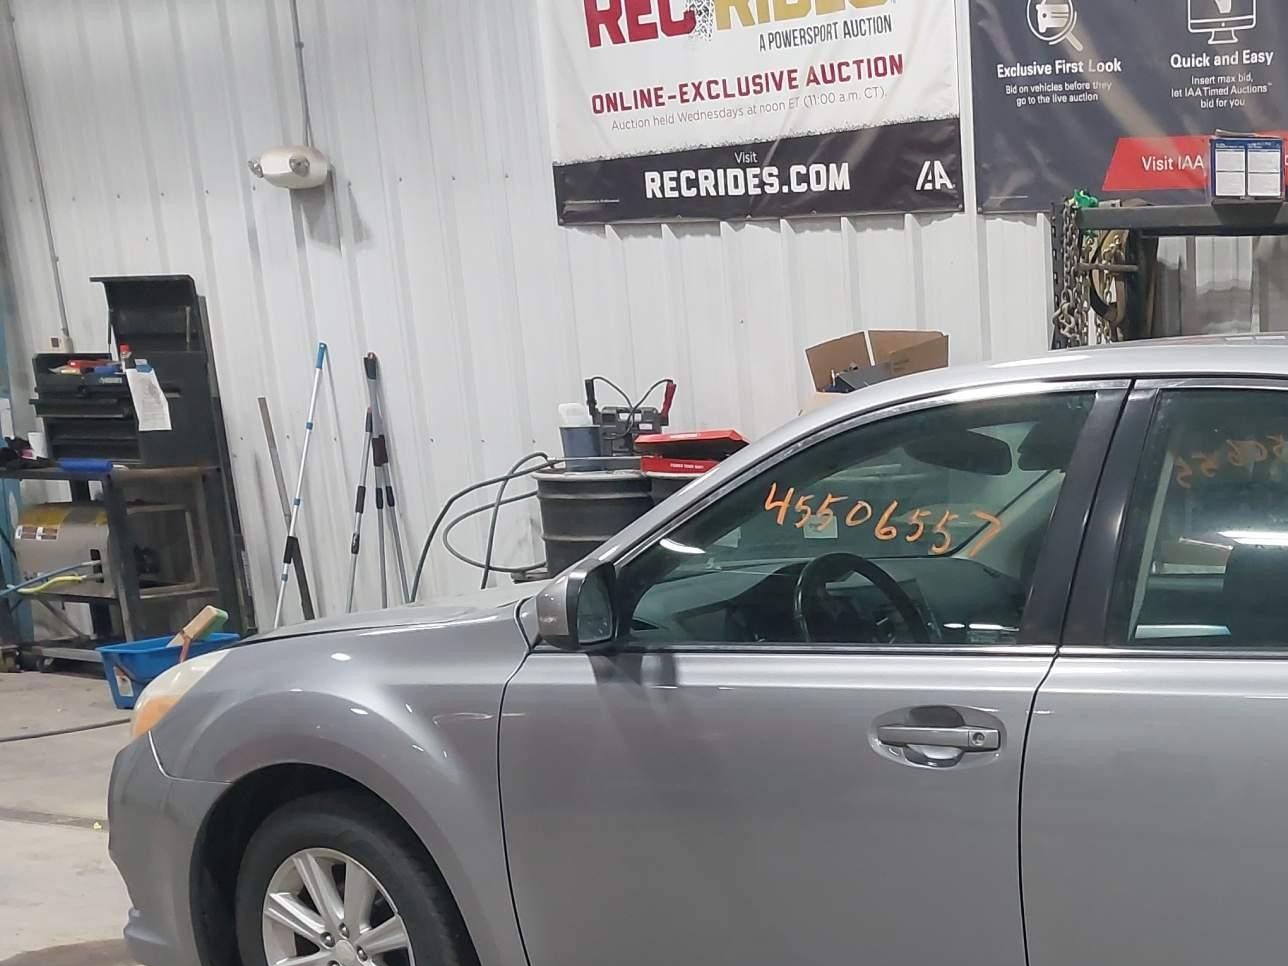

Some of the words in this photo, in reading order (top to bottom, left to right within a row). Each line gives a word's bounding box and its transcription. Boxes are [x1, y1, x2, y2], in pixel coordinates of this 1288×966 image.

[759, 33, 767, 52] A
[768, 22, 839, 50] POWERSPORT
[843, 14, 893, 39] AUCTION
[1170, 53, 1210, 68] Quick
[1213, 51, 1239, 66] and
[1242, 49, 1274, 66] Easy
[996, 61, 1052, 78] Exclusive
[1055, 59, 1084, 74] First
[1088, 57, 1122, 73] Look
[591, 69, 799, 114] ONLINE-EXCLUSIVE
[805, 53, 903, 87] AUCTION
[1005, 84, 1017, 94] Bid
[1018, 86, 1029, 94] on
[1030, 82, 1063, 93] vehicles
[1065, 80, 1090, 91] before
[1092, 80, 1112, 91] they
[1191, 75, 1216, 85] Insert
[1217, 75, 1235, 84] max
[1238, 72, 1253, 83] bid,
[1016, 97, 1026, 107] go
[1027, 96, 1036, 105] to
[1037, 94, 1050, 104] the
[1052, 93, 1067, 103] live
[1069, 92, 1098, 102] auction
[1171, 88, 1182, 98] let
[1184, 87, 1202, 97] IAA
[1203, 86, 1229, 96] Timed
[612, 117, 650, 131] Auction
[653, 114, 674, 127] held
[678, 106, 744, 122] Wednesdays
[747, 105, 757, 116] at
[759, 100, 786, 112] noon
[804, 93, 835, 108] (11:00
[1200, 98, 1214, 109] bid
[1216, 98, 1227, 107] for
[1229, 98, 1245, 109] you
[734, 151, 759, 164] Visit
[1141, 155, 1174, 171] Visit
[644, 162, 851, 199] RECRIDES.COM
[764, 482, 1004, 558] 45506557
